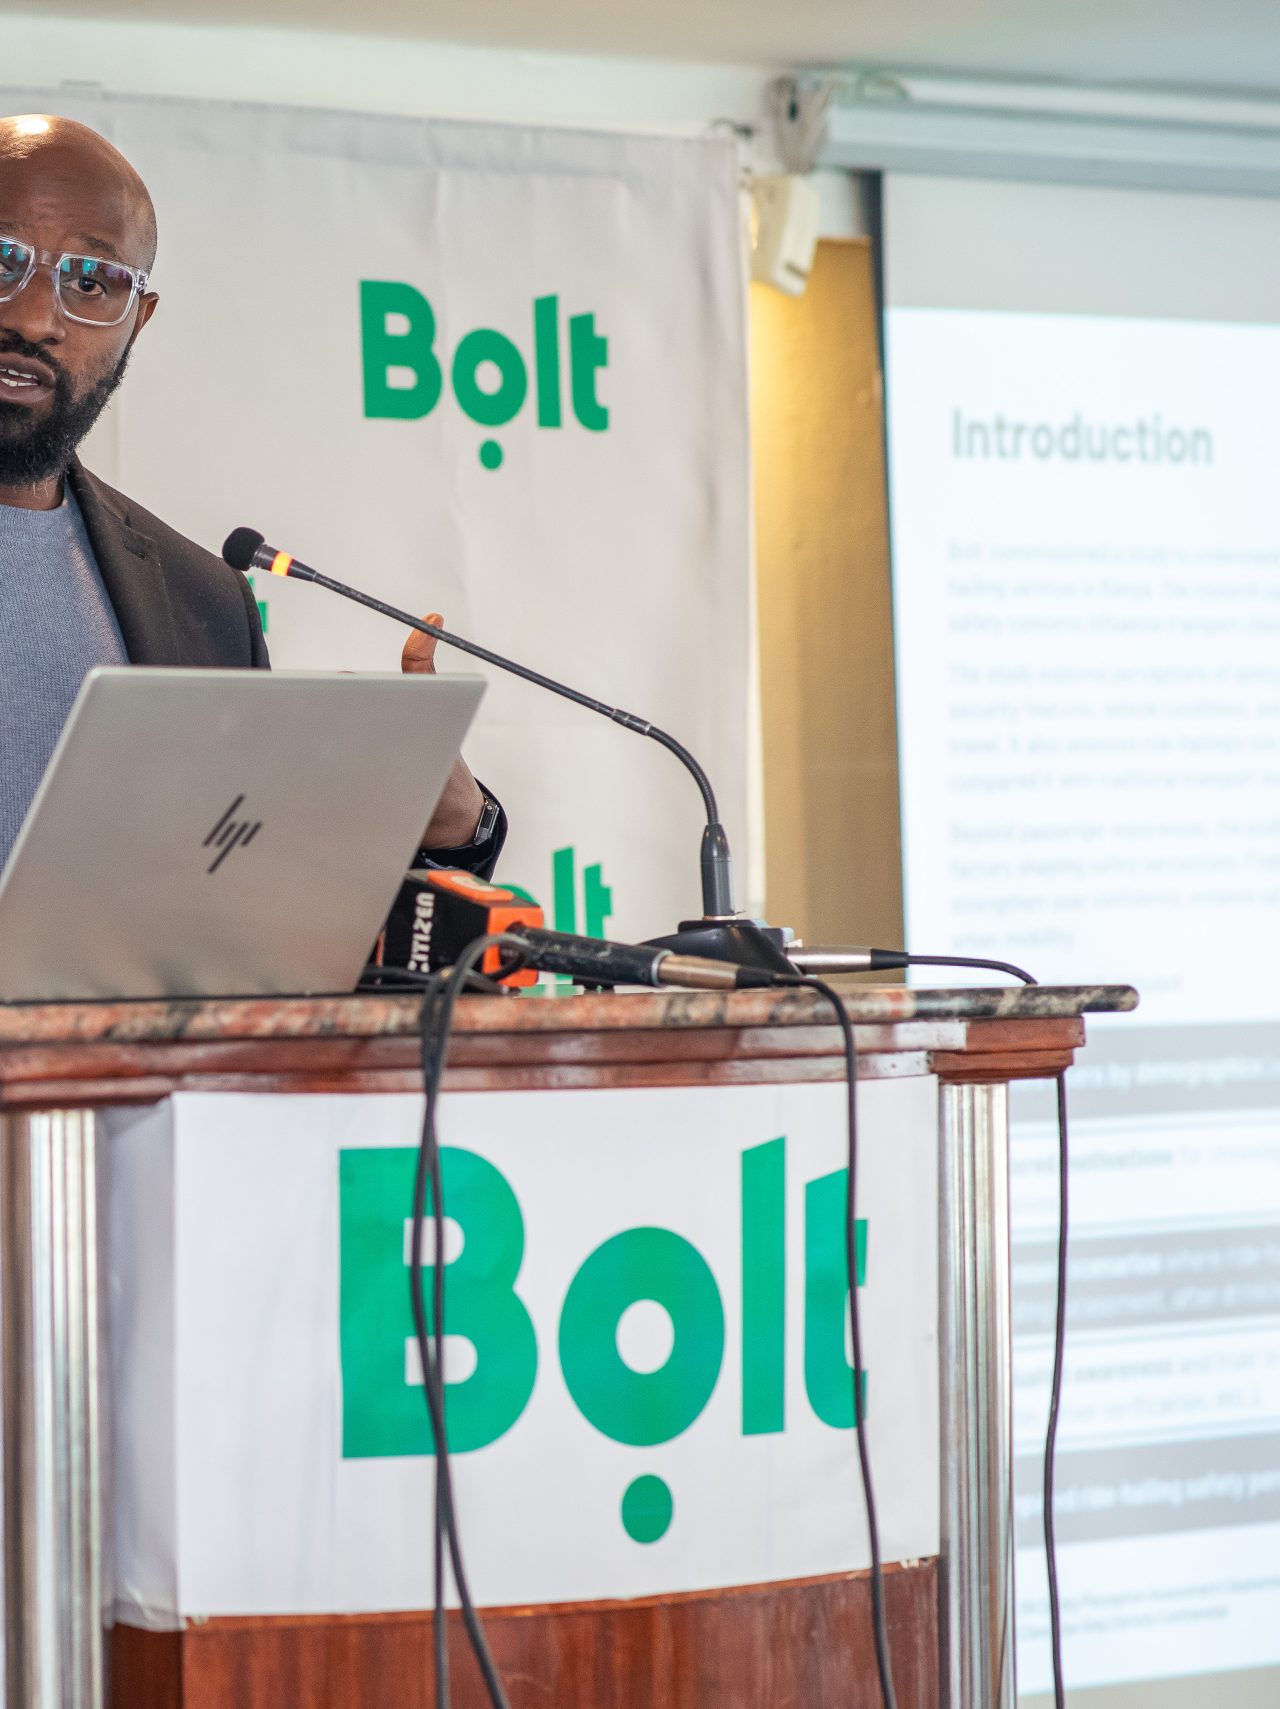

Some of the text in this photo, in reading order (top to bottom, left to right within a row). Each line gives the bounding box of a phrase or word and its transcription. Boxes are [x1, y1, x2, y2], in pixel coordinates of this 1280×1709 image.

[359, 280, 609, 470] Bolt
[952, 408, 1214, 466] Introduction
[338, 1136, 869, 1544] Bolt
